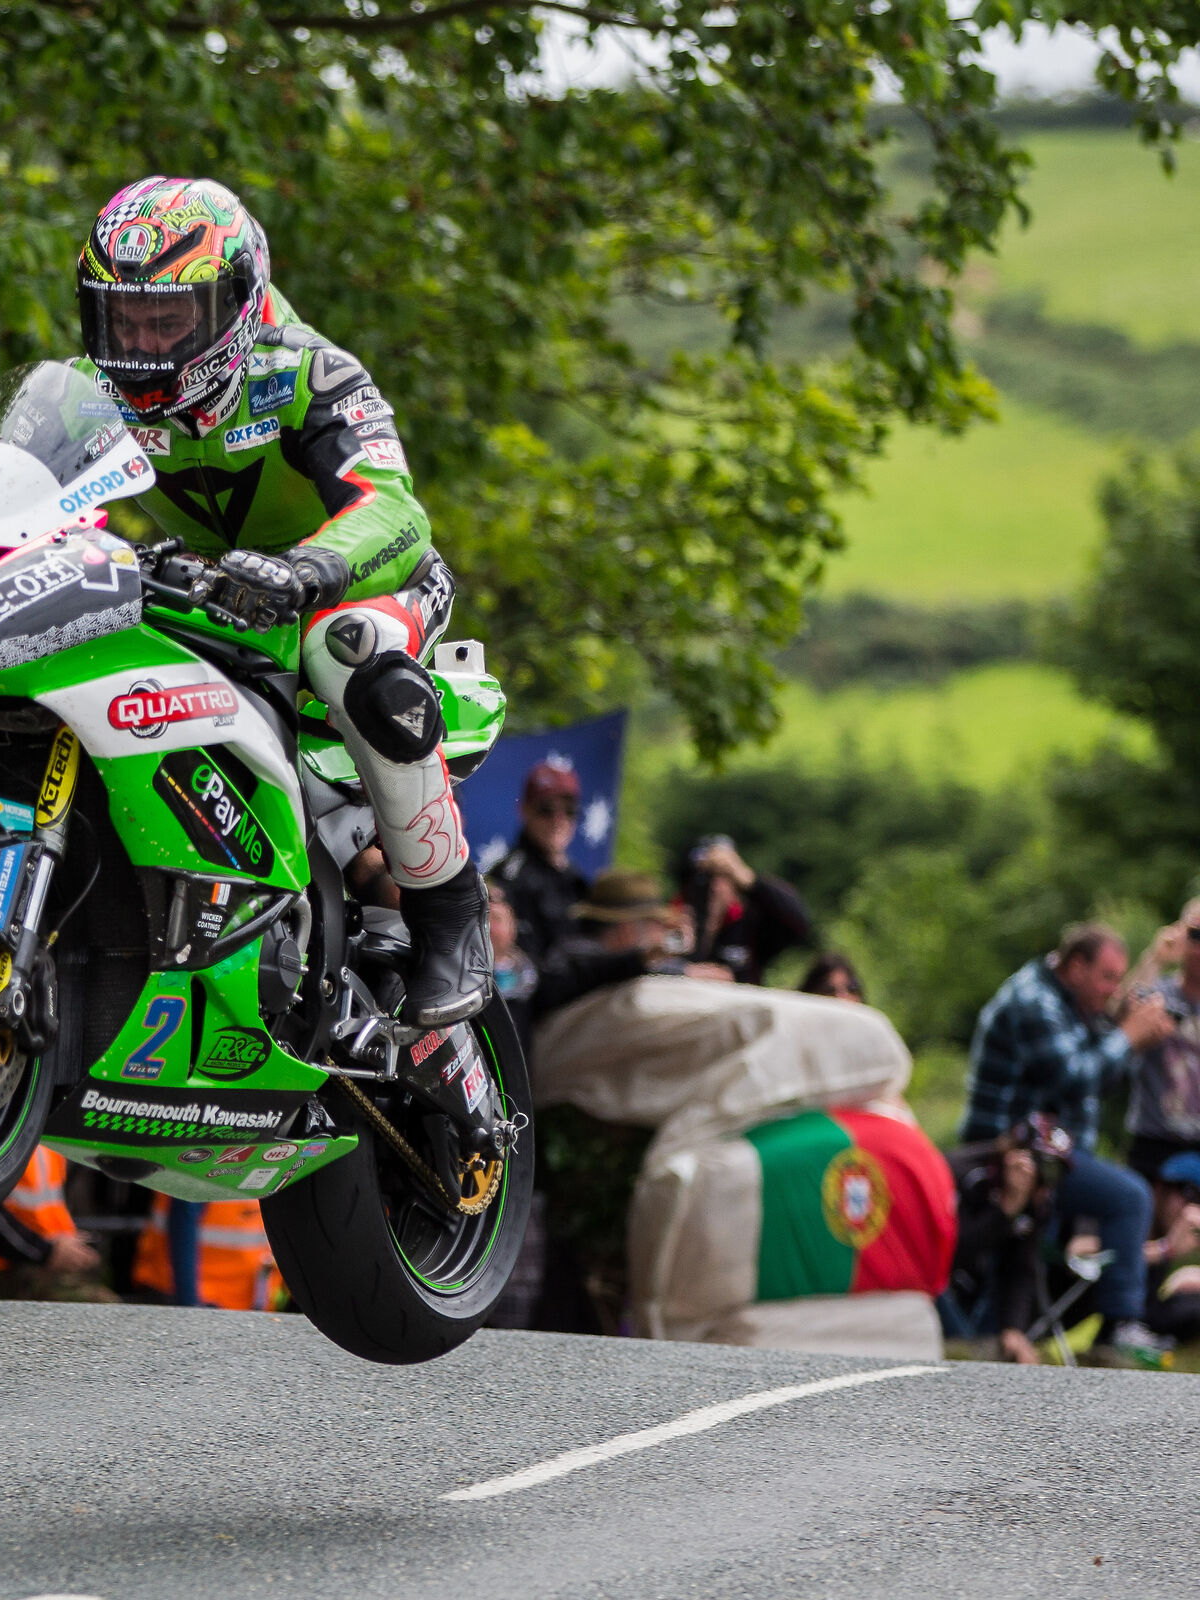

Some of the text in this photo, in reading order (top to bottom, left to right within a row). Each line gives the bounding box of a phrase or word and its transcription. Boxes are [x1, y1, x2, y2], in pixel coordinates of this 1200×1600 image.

[110, 282, 142, 293] Advice
[143, 284, 193, 293] Solicitors
[226, 418, 280, 444] OXFORD
[59, 470, 125, 513] OXFORD
[349, 521, 421, 586] Kawasaki
[118, 689, 235, 726] QUATTRO
[197, 921, 221, 931] COATINGS
[201, 912, 223, 923] WICKED
[120, 994, 187, 1080] 2
[81, 1089, 201, 1123] Bournemouth
[203, 1104, 283, 1129] Kawasaki
